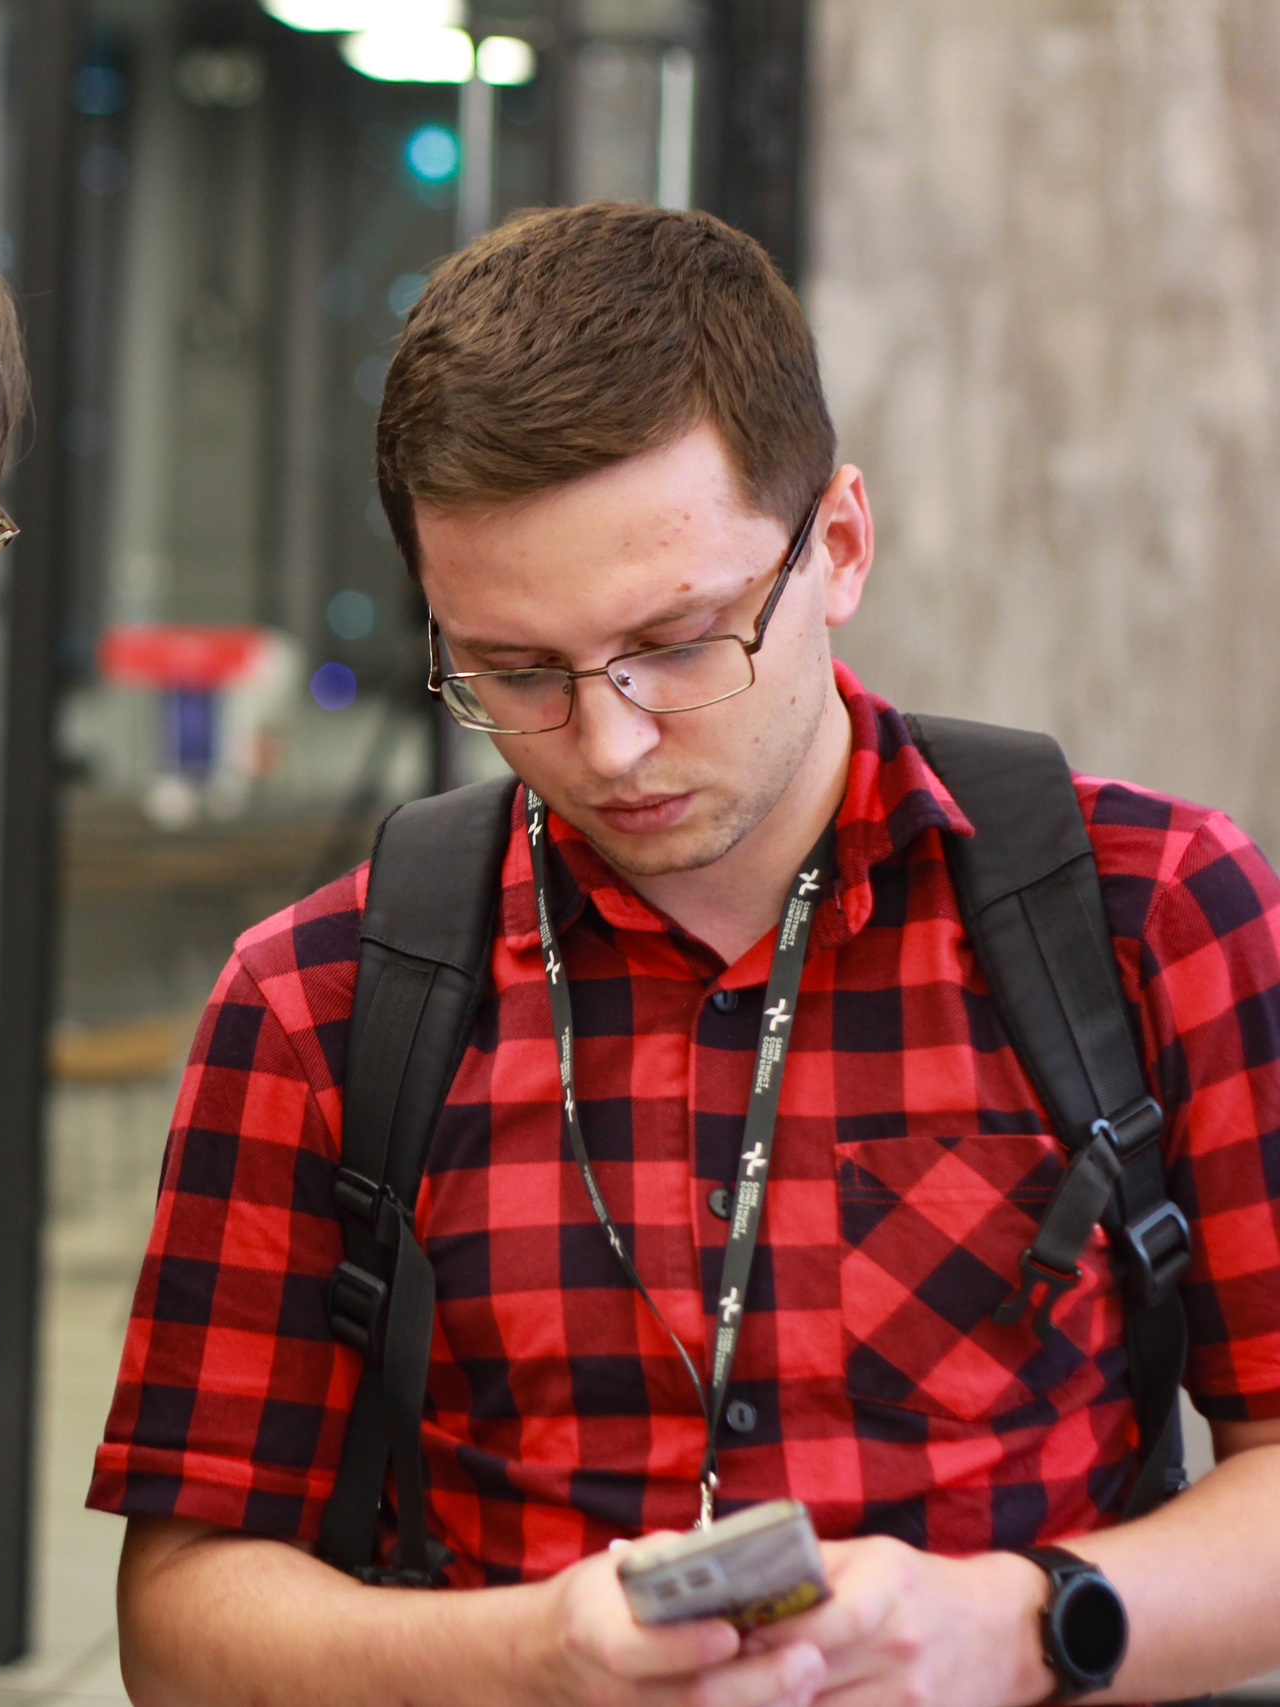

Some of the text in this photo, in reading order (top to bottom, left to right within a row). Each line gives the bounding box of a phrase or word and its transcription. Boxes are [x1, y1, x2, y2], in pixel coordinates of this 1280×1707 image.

[779, 898, 798, 951] CONFERENCE
[788, 900, 805, 947] CONSTRUCT
[800, 901, 811, 922] GAME
[754, 1036, 770, 1094] CONFERENCE
[762, 1036, 777, 1088] CONSTRUCT
[773, 1037, 783, 1062] GAME
